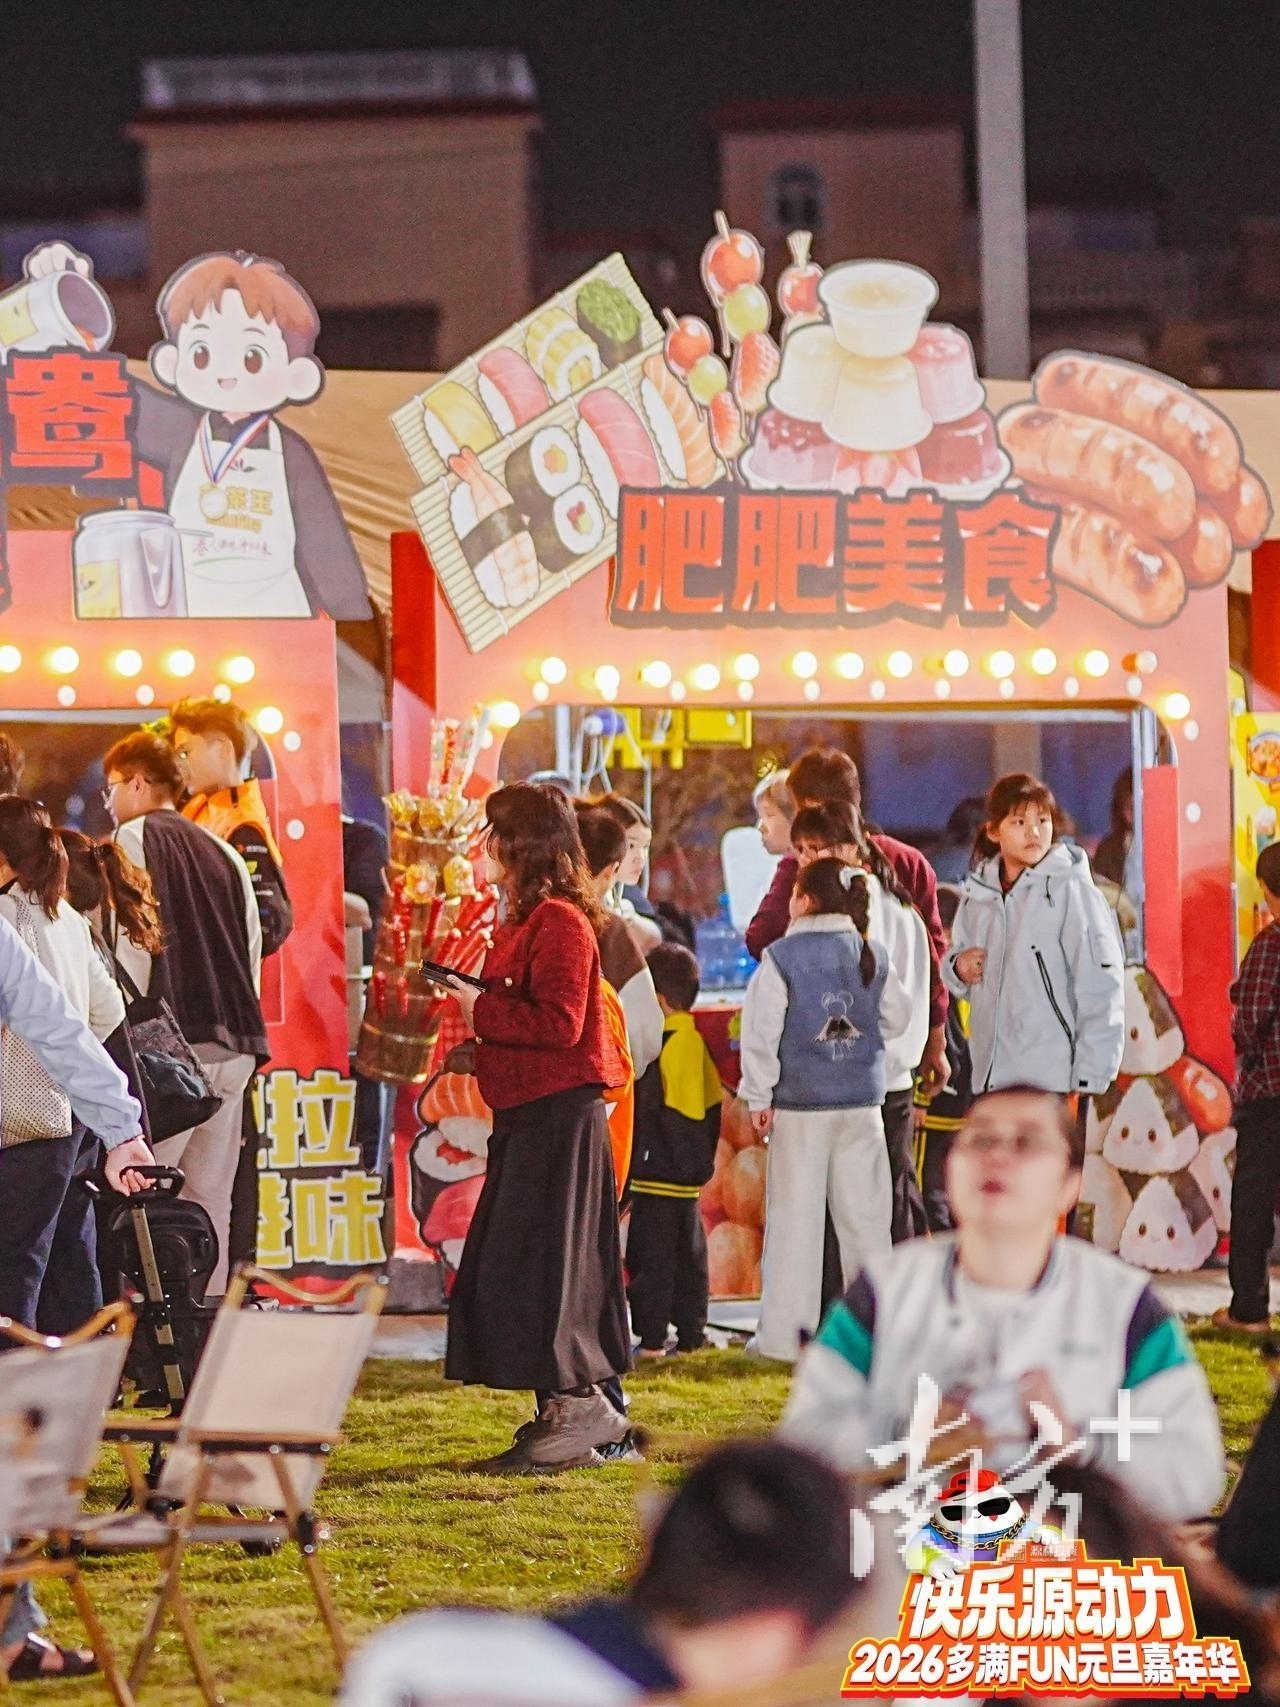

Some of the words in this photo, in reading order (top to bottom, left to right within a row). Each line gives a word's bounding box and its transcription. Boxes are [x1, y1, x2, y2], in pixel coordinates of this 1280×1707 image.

[199, 484, 273, 516] 茶王
[615, 494, 1058, 614] 肥肥美食
